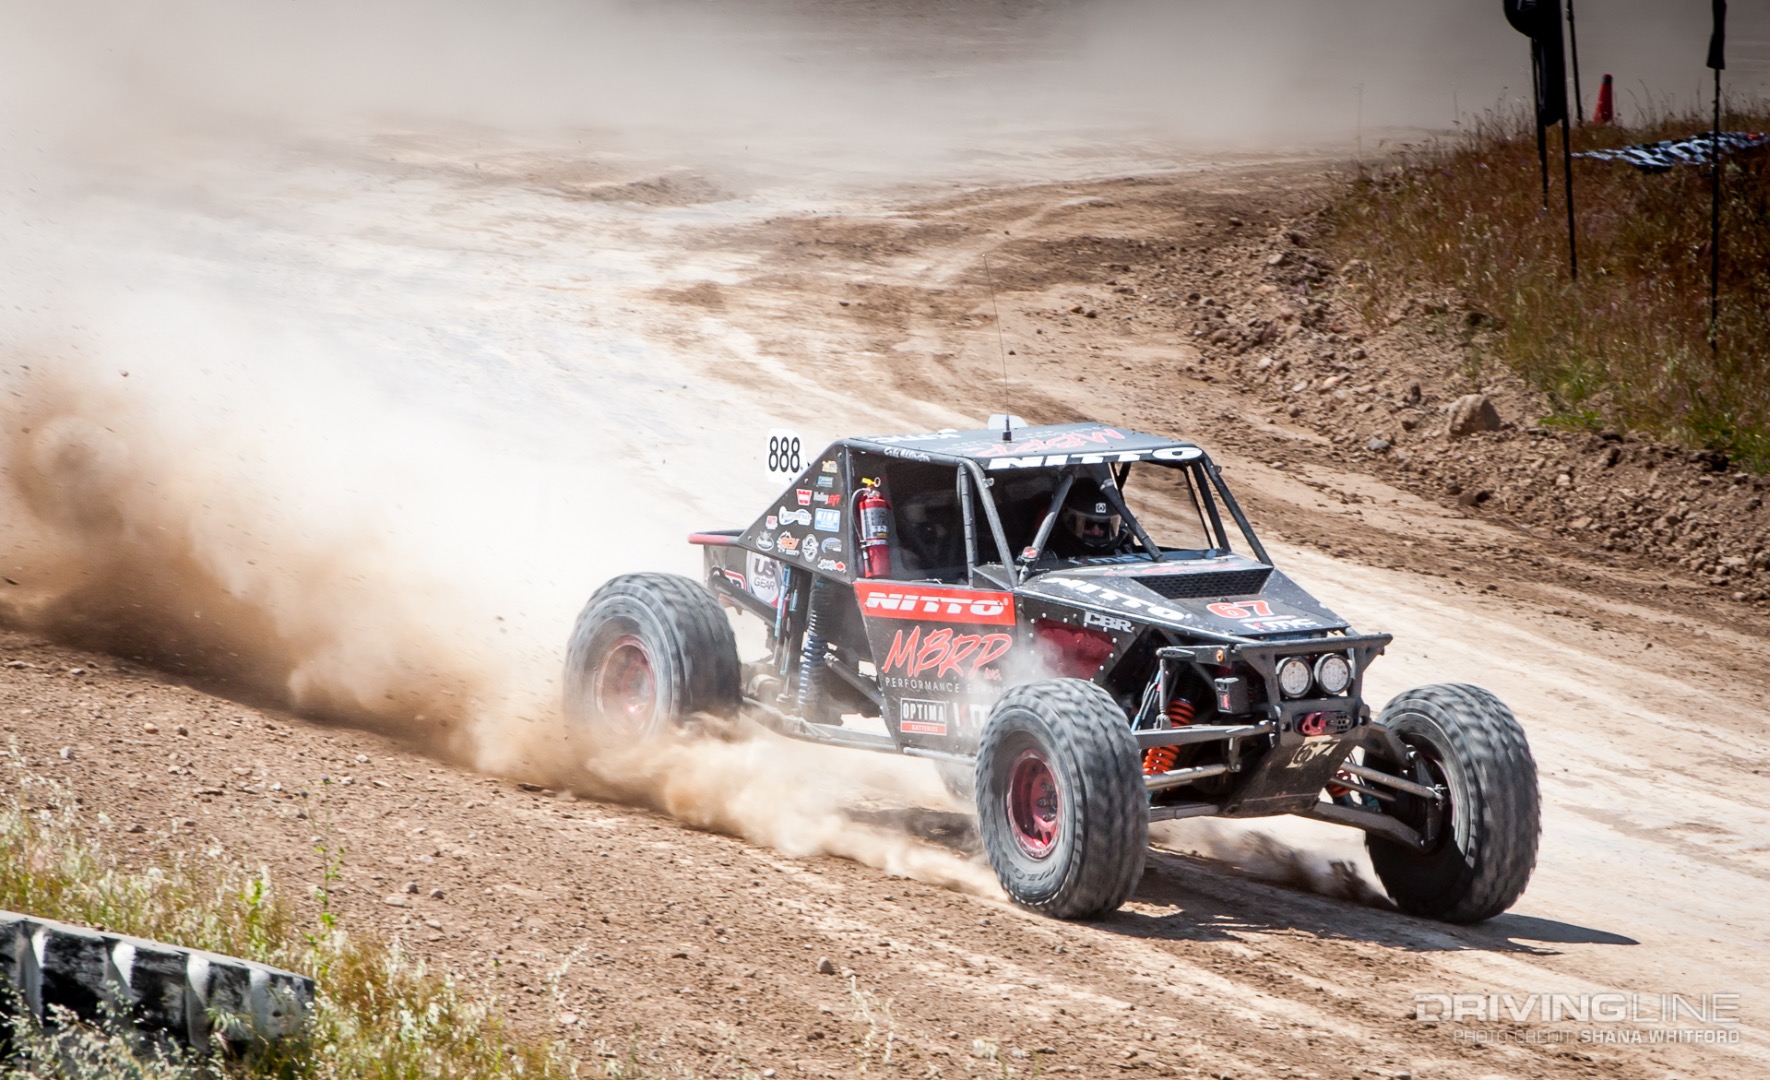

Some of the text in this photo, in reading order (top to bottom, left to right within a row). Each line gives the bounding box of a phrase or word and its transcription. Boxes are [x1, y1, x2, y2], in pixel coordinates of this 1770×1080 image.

[769, 436, 800, 473] 888
[988, 447, 1203, 470] NITTO
[754, 557, 777, 579] US
[754, 576, 776, 591] GEAR
[864, 591, 1005, 616] NITTO
[1040, 577, 1185, 621] NITTO
[1206, 599, 1274, 619] 67
[1085, 610, 1132, 633] CBR
[883, 625, 1013, 680] MBRP
[885, 676, 960, 693] PERFORMANCE
[902, 702, 945, 721] OPTIMA
[1292, 740, 1340, 766] 67
